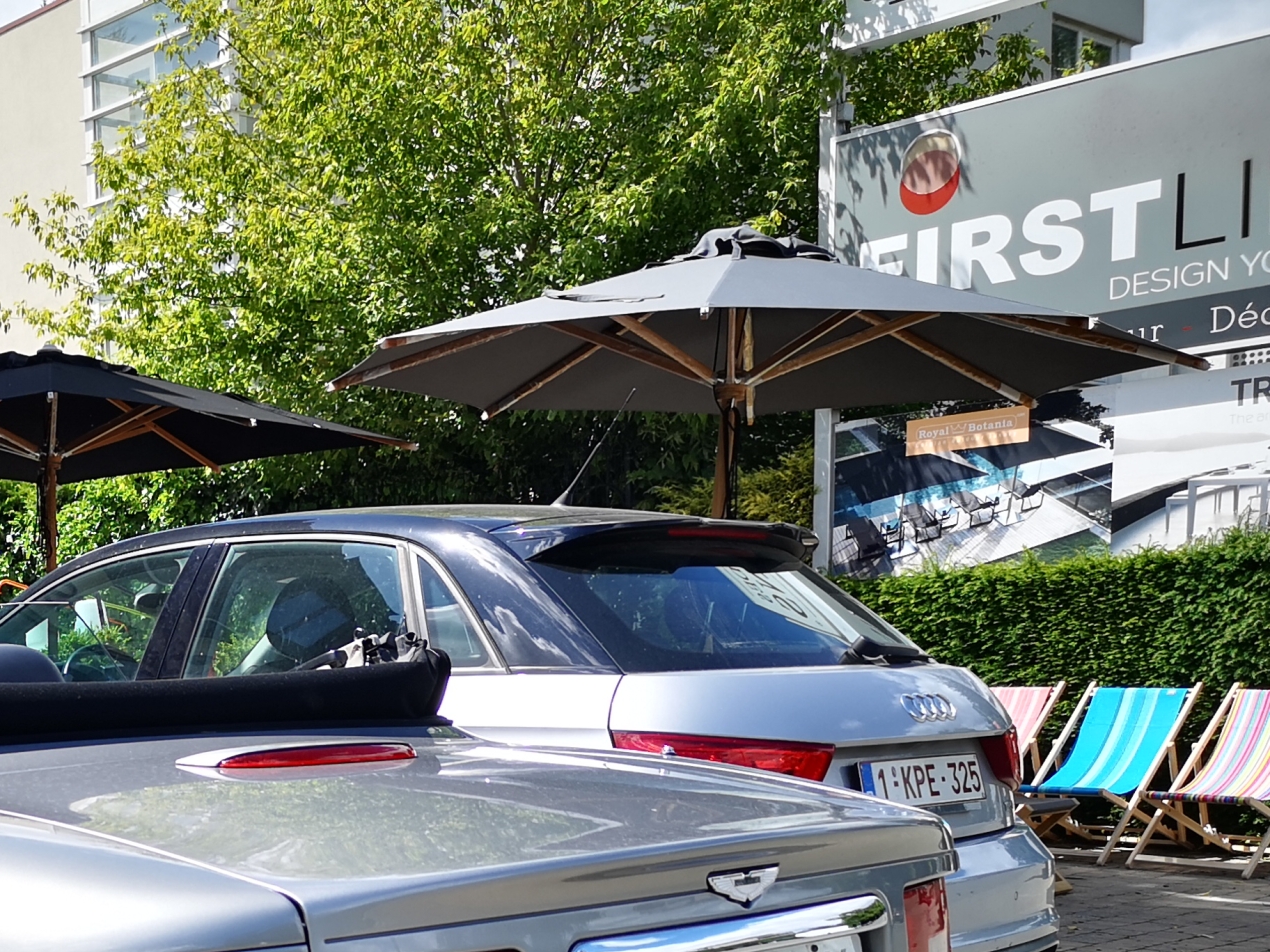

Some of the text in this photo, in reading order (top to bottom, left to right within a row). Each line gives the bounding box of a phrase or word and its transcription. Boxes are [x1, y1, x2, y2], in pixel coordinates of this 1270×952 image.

[1109, 256, 1229, 301] DESIGN
[918, 426, 949, 440] Royal
[968, 419, 1013, 432] Botania
